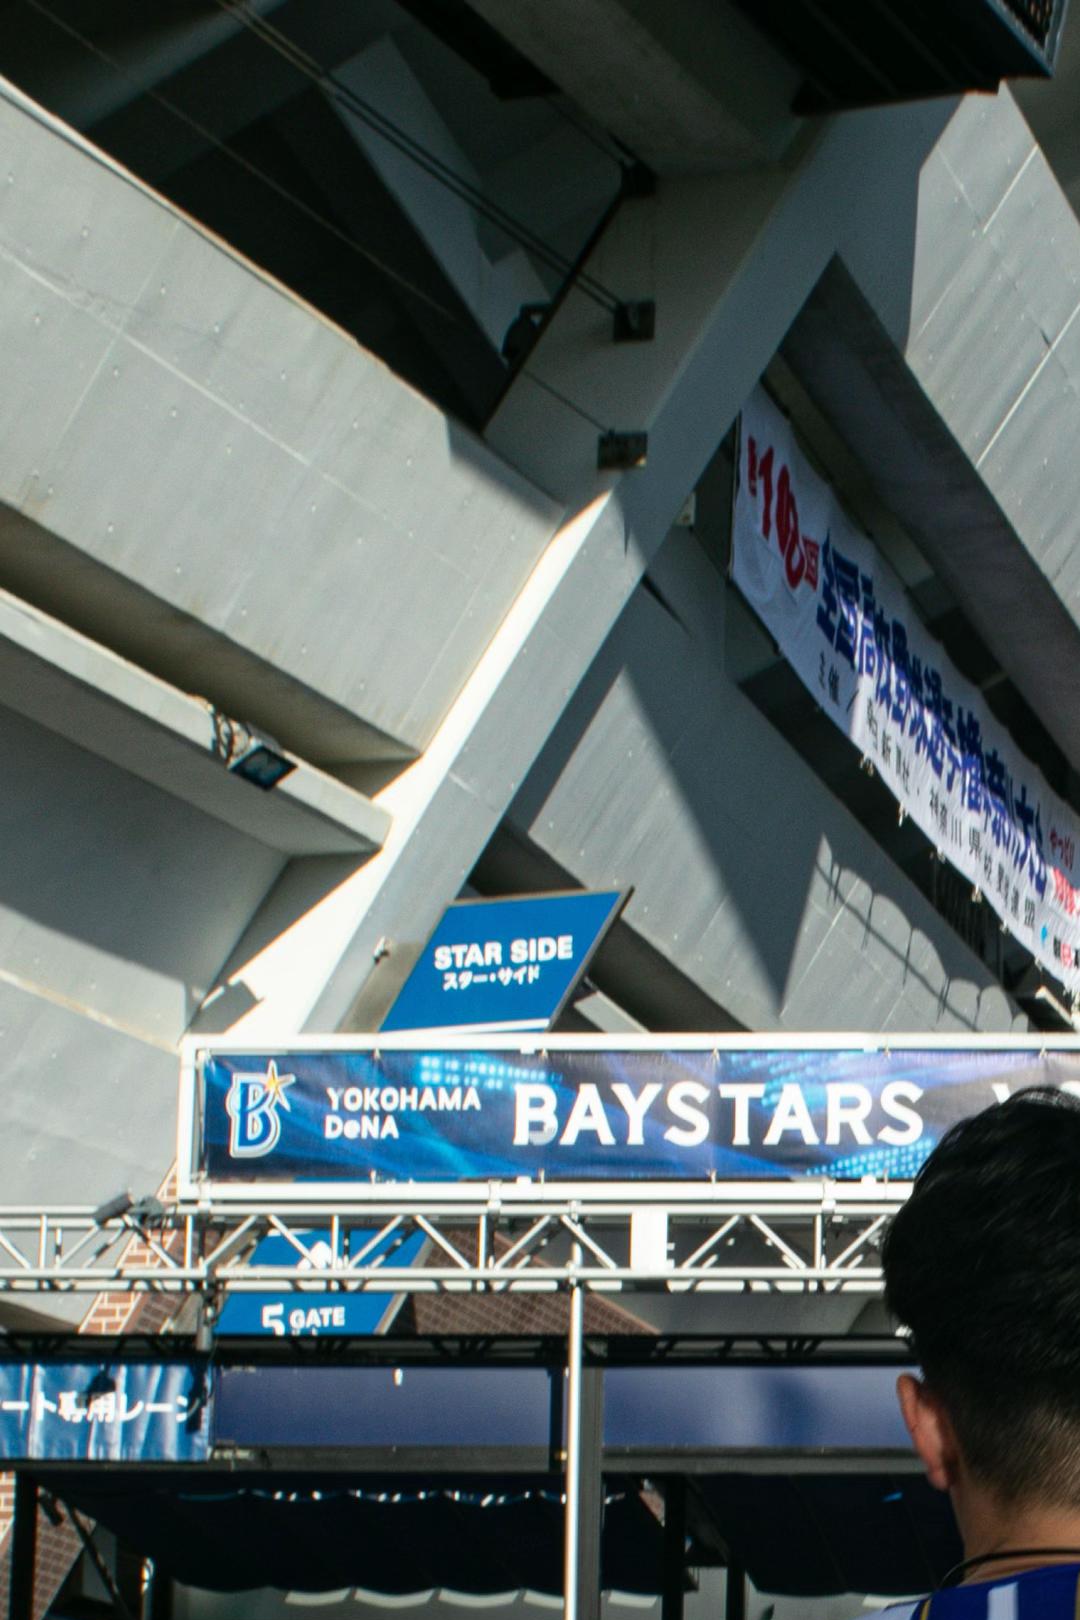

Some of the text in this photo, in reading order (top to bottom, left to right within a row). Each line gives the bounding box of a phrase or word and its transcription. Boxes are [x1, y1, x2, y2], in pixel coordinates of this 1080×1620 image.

[434, 934, 573, 970] STAR SIDE
[442, 963, 540, 992] スター・サイド
[325, 1086, 482, 1112] YOKOHAMA
[512, 1081, 925, 1147] BAYSTARS
[323, 1114, 400, 1140] DeNA
[262, 1303, 346, 1336] 5 GATE
